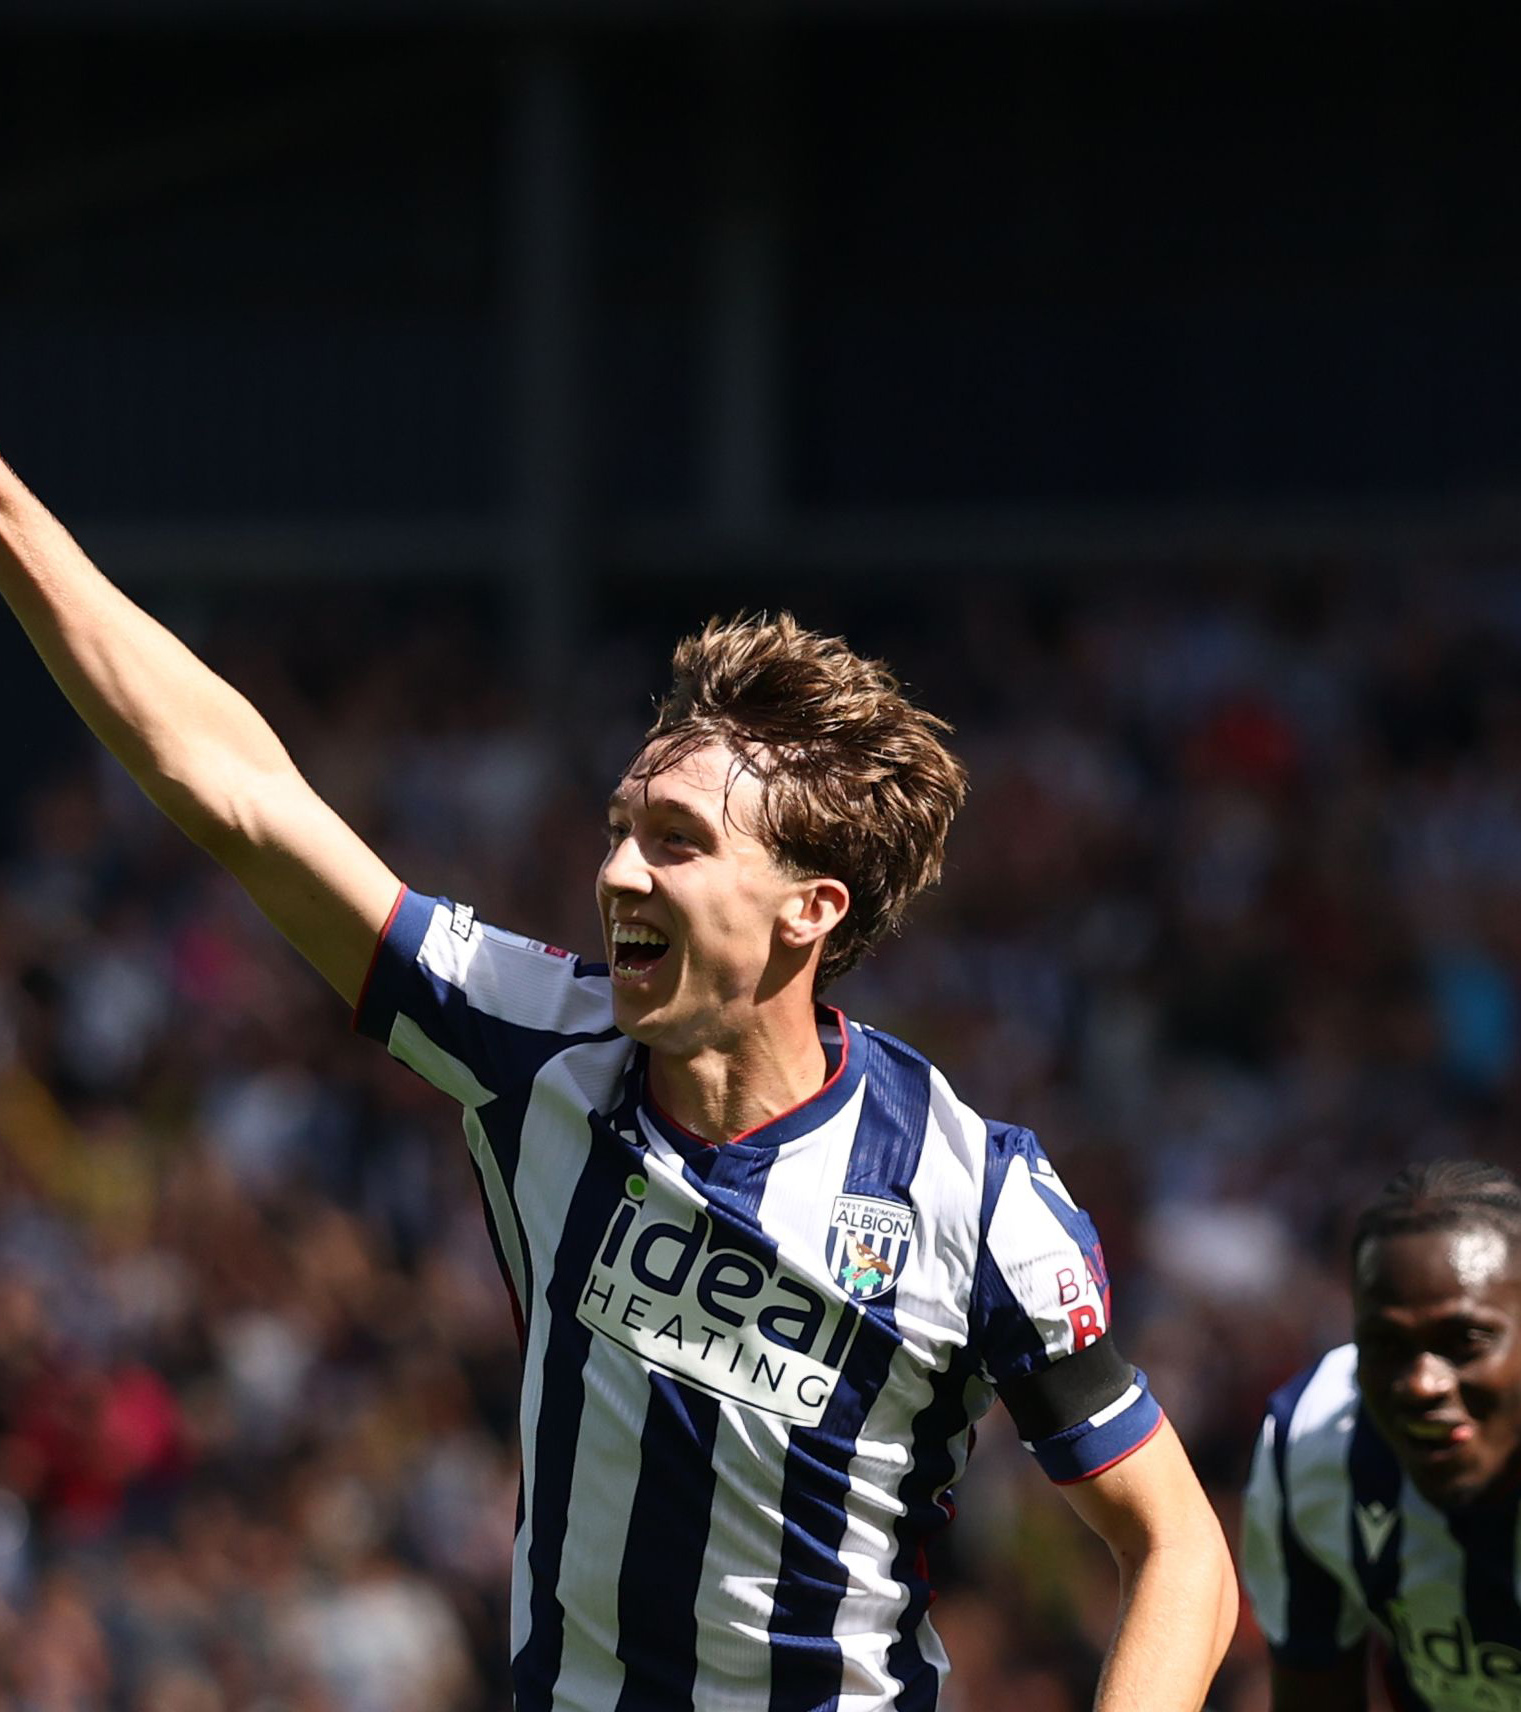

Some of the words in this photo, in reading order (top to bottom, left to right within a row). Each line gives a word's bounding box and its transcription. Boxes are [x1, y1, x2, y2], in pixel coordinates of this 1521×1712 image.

[835, 1209, 910, 1237] ALBION
[838, 1201, 861, 1211] WEST
[863, 1205, 914, 1221] BROMWICH
[600, 1174, 859, 1370] ideal
[582, 1274, 829, 1408] HEATING
